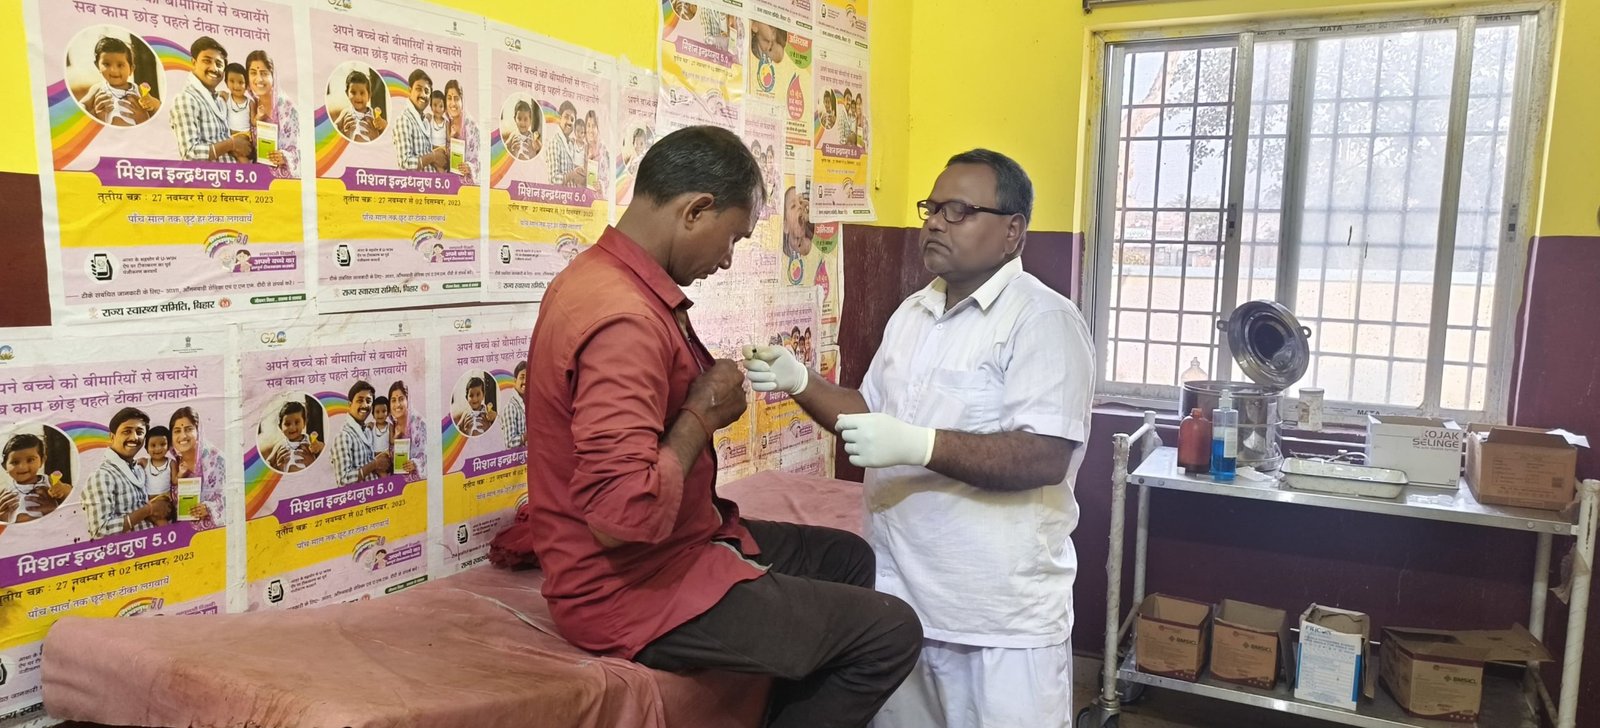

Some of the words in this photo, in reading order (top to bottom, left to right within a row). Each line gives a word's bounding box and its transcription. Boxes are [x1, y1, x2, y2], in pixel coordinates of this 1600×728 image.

[73, 1, 97, 14] सब
[101, 4, 128, 20] काम
[132, 7, 159, 28] छोड़
[162, 14, 189, 30] पहले
[193, 18, 219, 34] टीका
[332, 23, 354, 38] अपने
[356, 28, 376, 42] बच्चे
[377, 31, 389, 45] को
[332, 41, 349, 54] सब
[350, 44, 369, 57] काम
[371, 46, 389, 63] छोड़
[391, 52, 409, 65] पहले
[410, 54, 428, 67] टीका
[519, 78, 533, 89] काम
[116, 160, 163, 181] मिशन
[165, 167, 231, 187] इन्द्रधनुष
[235, 169, 257, 183] 5.0
[355, 168, 387, 187] मिशन
[388, 174, 432, 192] इन्द्रधनुष
[434, 177, 450, 190] 5.0
[97, 191, 123, 204] तृतीय
[126, 192, 141, 201] चक्र
[152, 194, 163, 202] 27
[166, 193, 194, 202] नवम्बर
[207, 194, 217, 203] 02
[254, 195, 274, 204] 2023
[518, 183, 540, 198] मिशन
[574, 192, 586, 203] 5.0
[101, 307, 124, 318] राज्य
[126, 304, 158, 316] स्वास्थ्य
[160, 300, 191, 312] समिति,
[193, 299, 215, 310] बिहार
[266, 357, 289, 371] अपने
[291, 355, 313, 369] बच्चे
[315, 353, 328, 366] को
[330, 350, 366, 366] बीमारियों
[369, 349, 377, 360] से
[457, 356, 469, 367] सब
[470, 354, 484, 364] काम
[0, 378, 17, 395] पने
[23, 375, 55, 393] बच्चे
[60, 373, 79, 391] को
[83, 369, 137, 389] बीमारियों
[141, 368, 153, 385] से
[155, 364, 199, 382] बचायेंगे
[266, 376, 283, 389] सब
[285, 374, 305, 386] काम
[308, 370, 327, 385] छोड़
[328, 367, 348, 381] पहले
[351, 366, 370, 379] टीका
[12, 400, 43, 416] काम
[49, 394, 76, 414] छोड़
[80, 391, 109, 409] पहले
[114, 390, 143, 404] टीका
[147, 382, 198, 401] लगवायेंगे
[1412, 438, 1460, 449] SELINGE
[472, 458, 497, 472] मिशन
[290, 496, 325, 515] मिशन
[326, 485, 374, 509] इन्द्रधनुष
[377, 482, 394, 495] 5.0
[315, 520, 323, 528] 27
[17, 552, 70, 577] मिशन
[74, 536, 148, 567] इन्द्रधनुष
[152, 530, 177, 547] 5.0
[27, 585, 45, 596] चक्र
[56, 581, 68, 591] 27
[72, 571, 104, 586] नवम्बर
[107, 567, 117, 577] से
[119, 566, 131, 576] 02
[173, 552, 195, 564] 2023
[28, 607, 47, 619] पाँच
[73, 597, 89, 607] तक
[119, 584, 139, 597] टीका
[0, 708, 17, 721] ज्य
